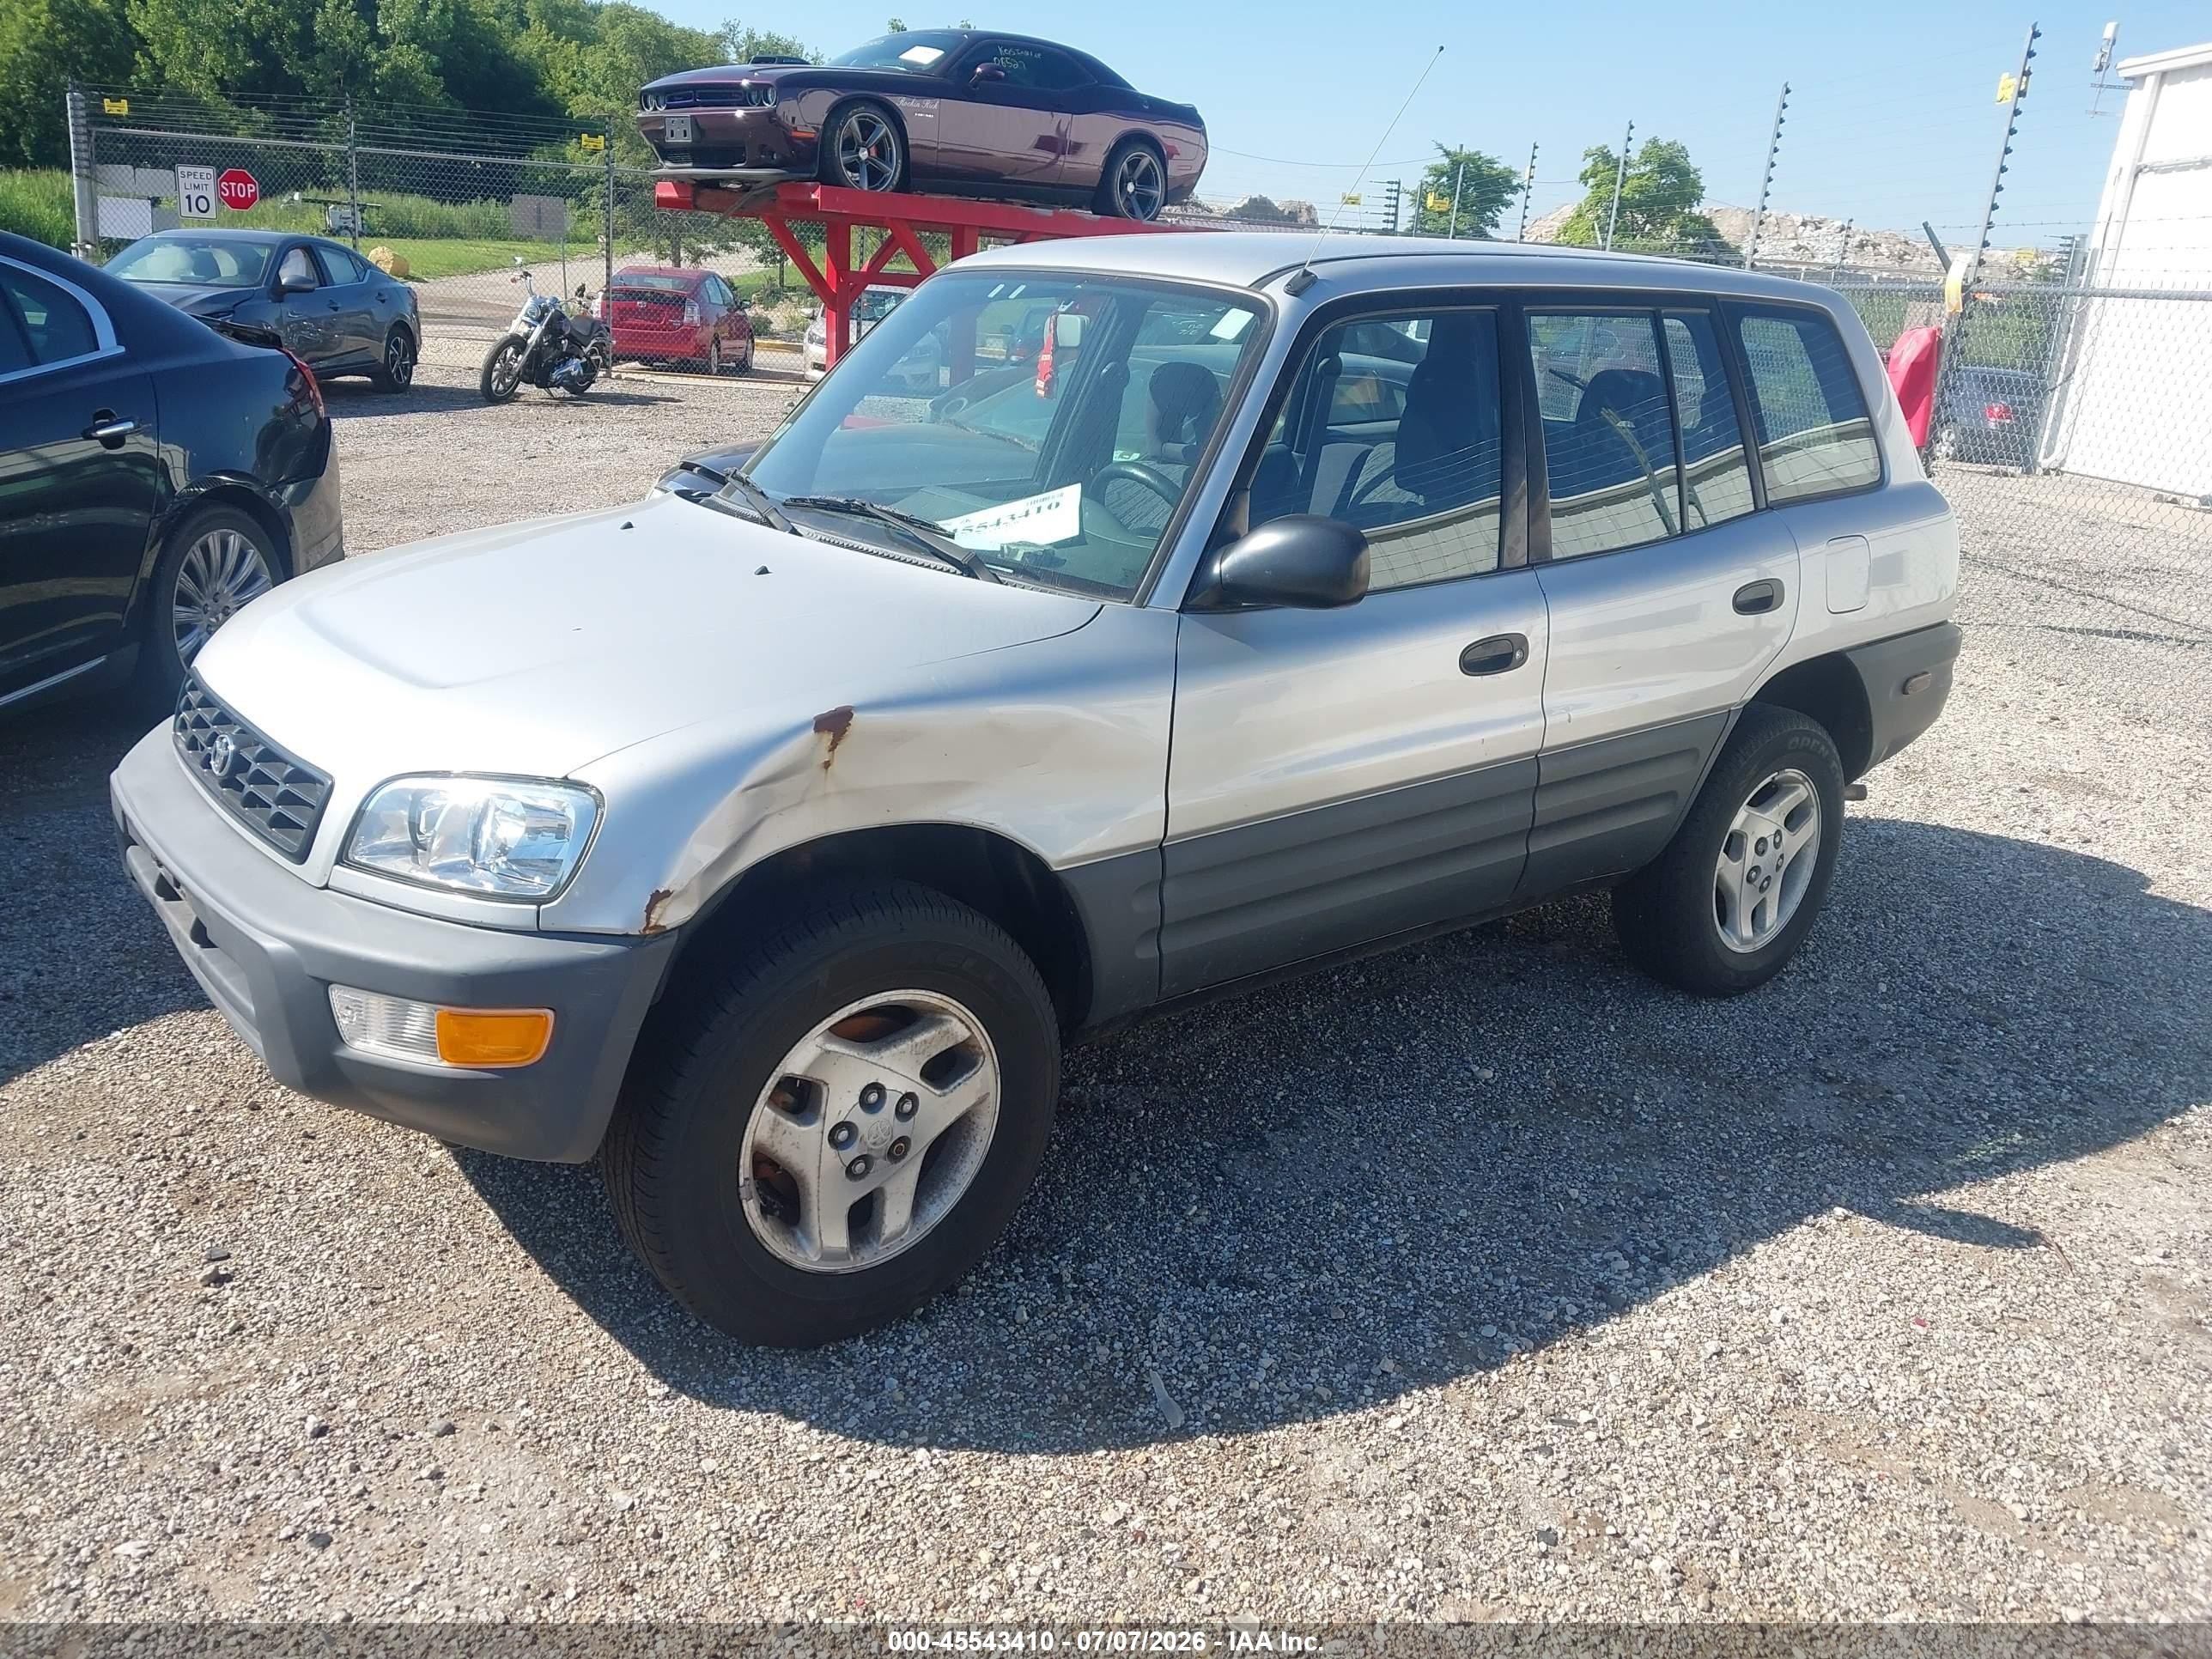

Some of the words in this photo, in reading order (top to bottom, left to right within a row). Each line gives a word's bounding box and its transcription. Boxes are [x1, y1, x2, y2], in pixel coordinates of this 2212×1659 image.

[179, 171, 212, 180] SPEED
[184, 182, 210, 191] LIMIT
[220, 181, 256, 198] STOP
[185, 194, 210, 214] 10
[1787, 736, 1830, 758] OPEN
